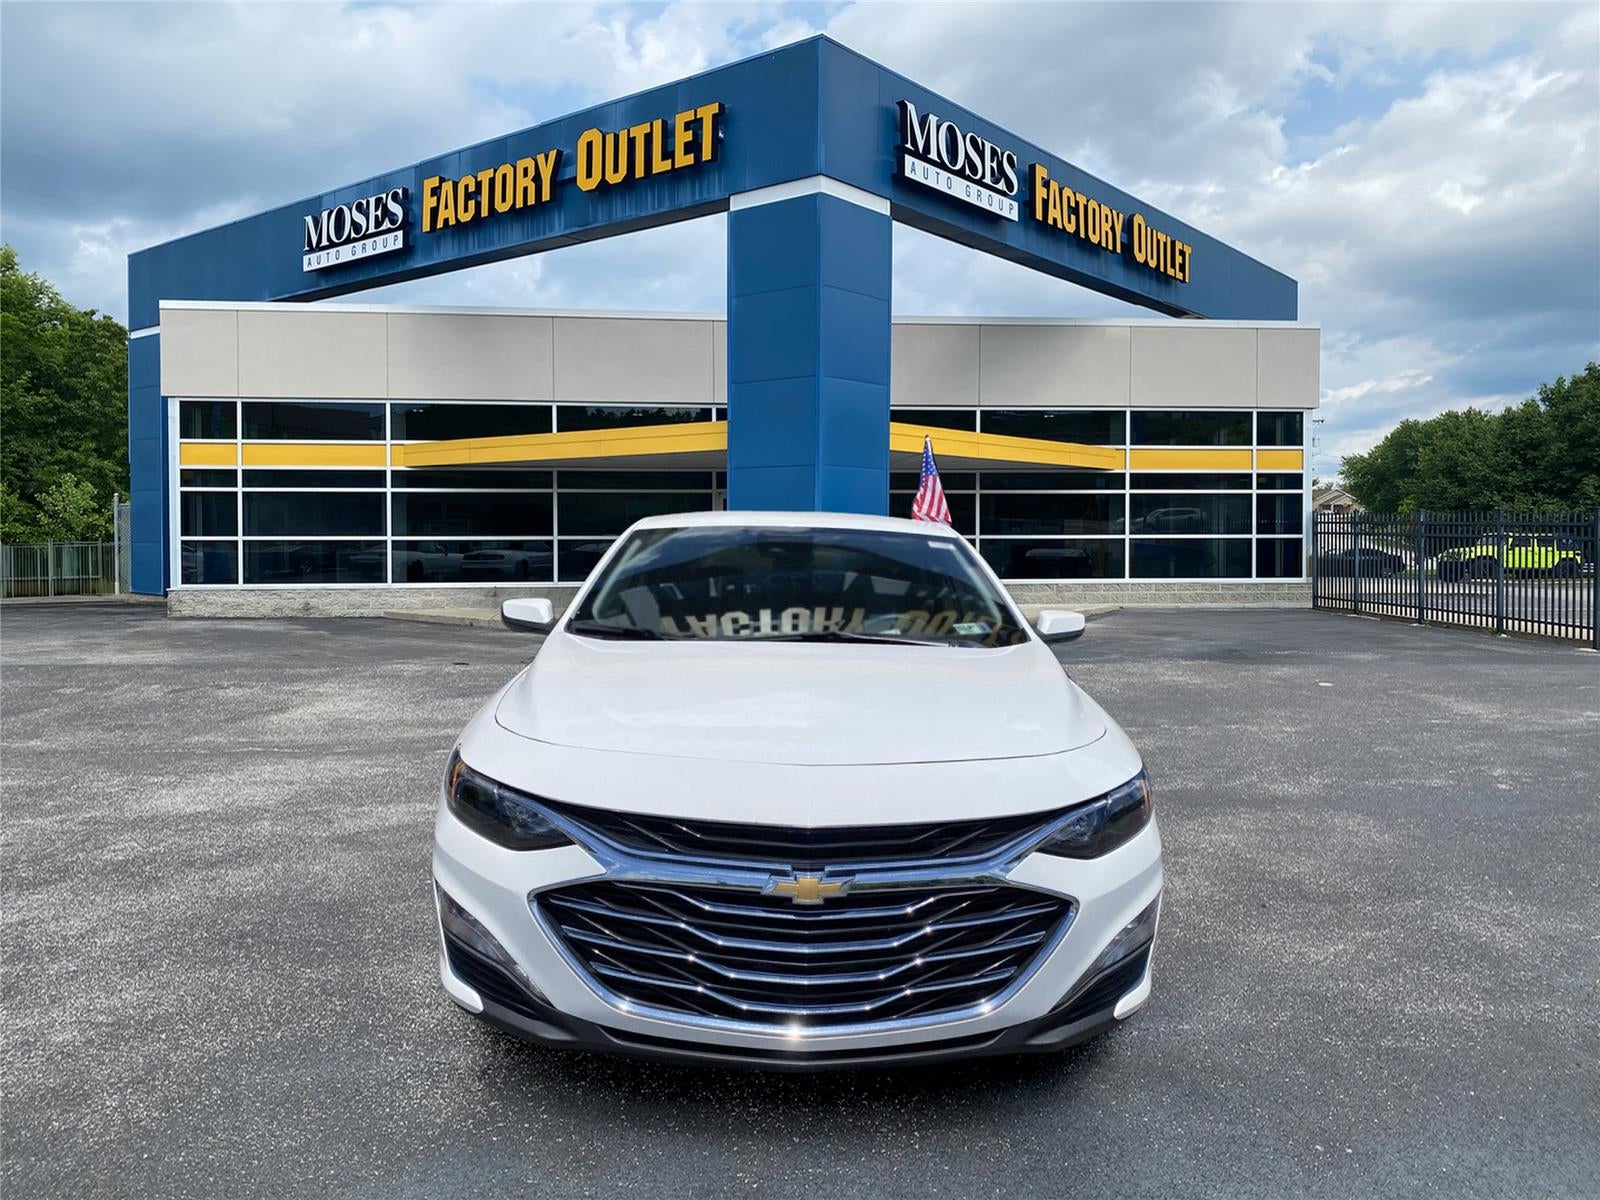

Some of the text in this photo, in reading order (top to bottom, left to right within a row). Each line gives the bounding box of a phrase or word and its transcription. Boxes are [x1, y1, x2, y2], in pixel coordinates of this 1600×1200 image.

[422, 102, 721, 233] FACTORY OUTLET
[904, 100, 1019, 196] MOSES
[910, 161, 1014, 215] AUTO GROUP
[303, 187, 404, 251] MOSES
[307, 234, 399, 267] AUTO GROUP
[1035, 163, 1192, 283] FACTORY OUTLET
